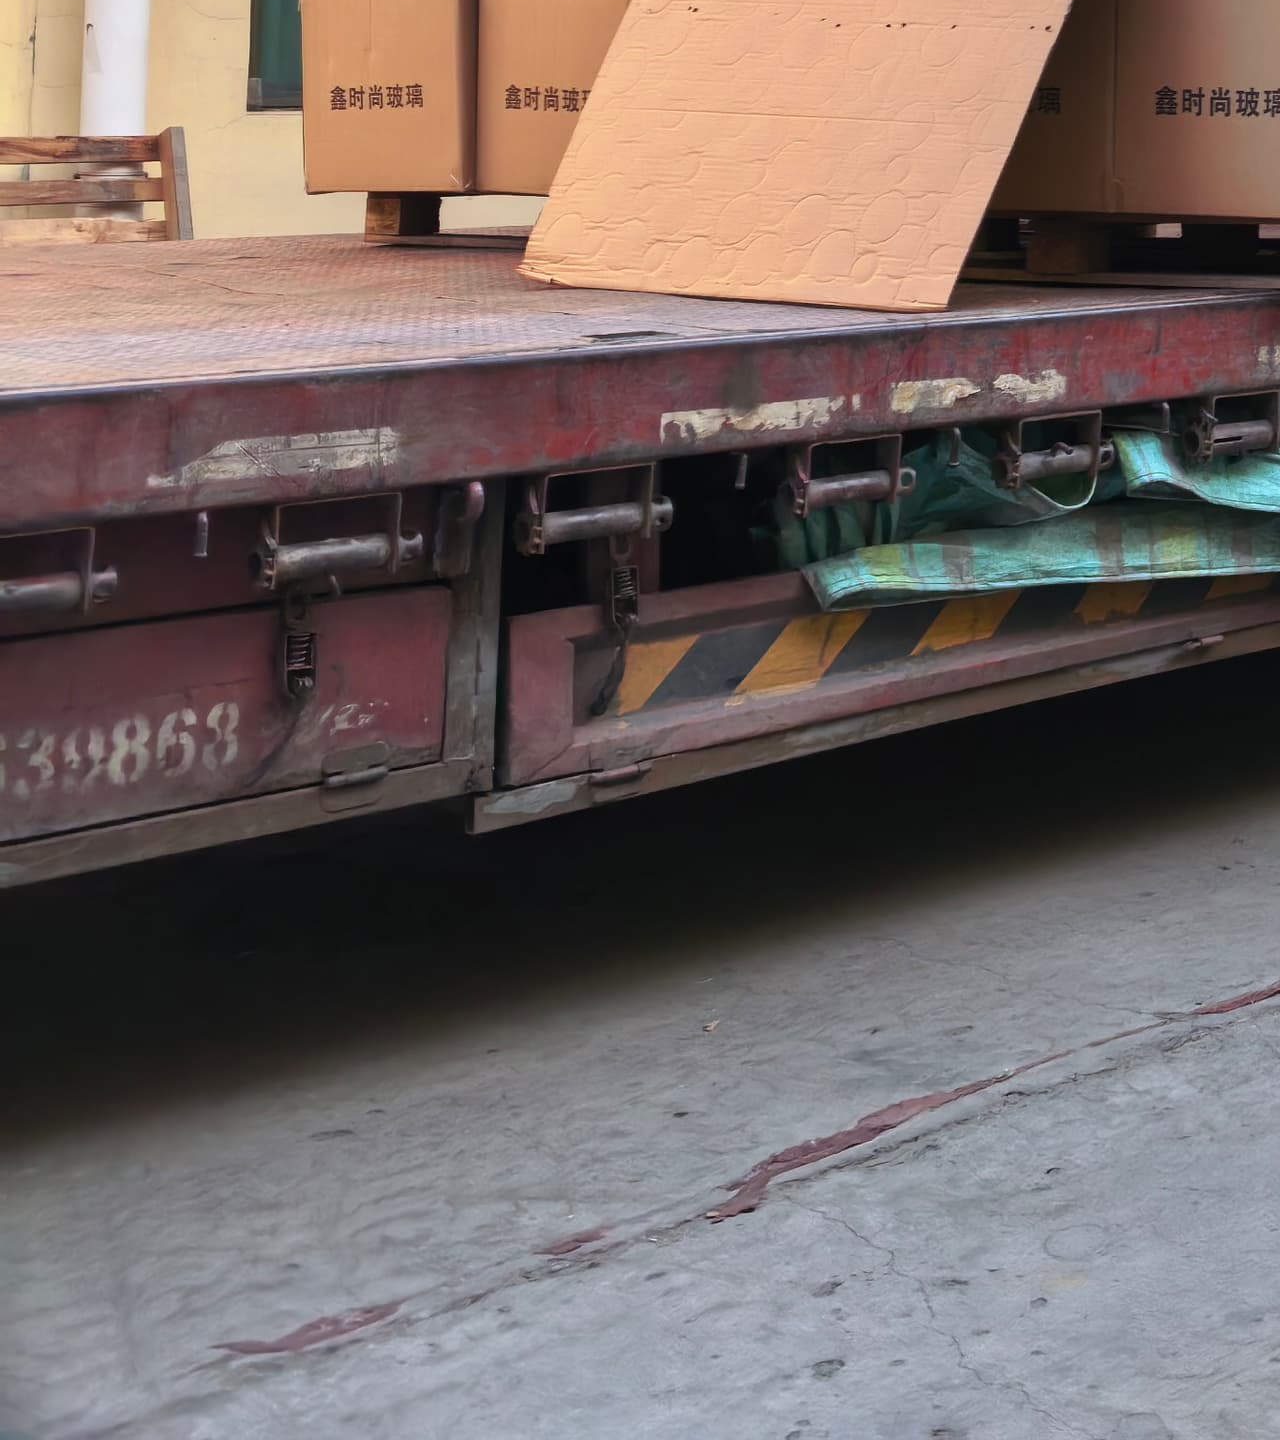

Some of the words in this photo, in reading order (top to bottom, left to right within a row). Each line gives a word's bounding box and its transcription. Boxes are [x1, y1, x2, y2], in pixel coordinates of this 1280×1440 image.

[330, 83, 424, 111] 鑫时尚玻璃
